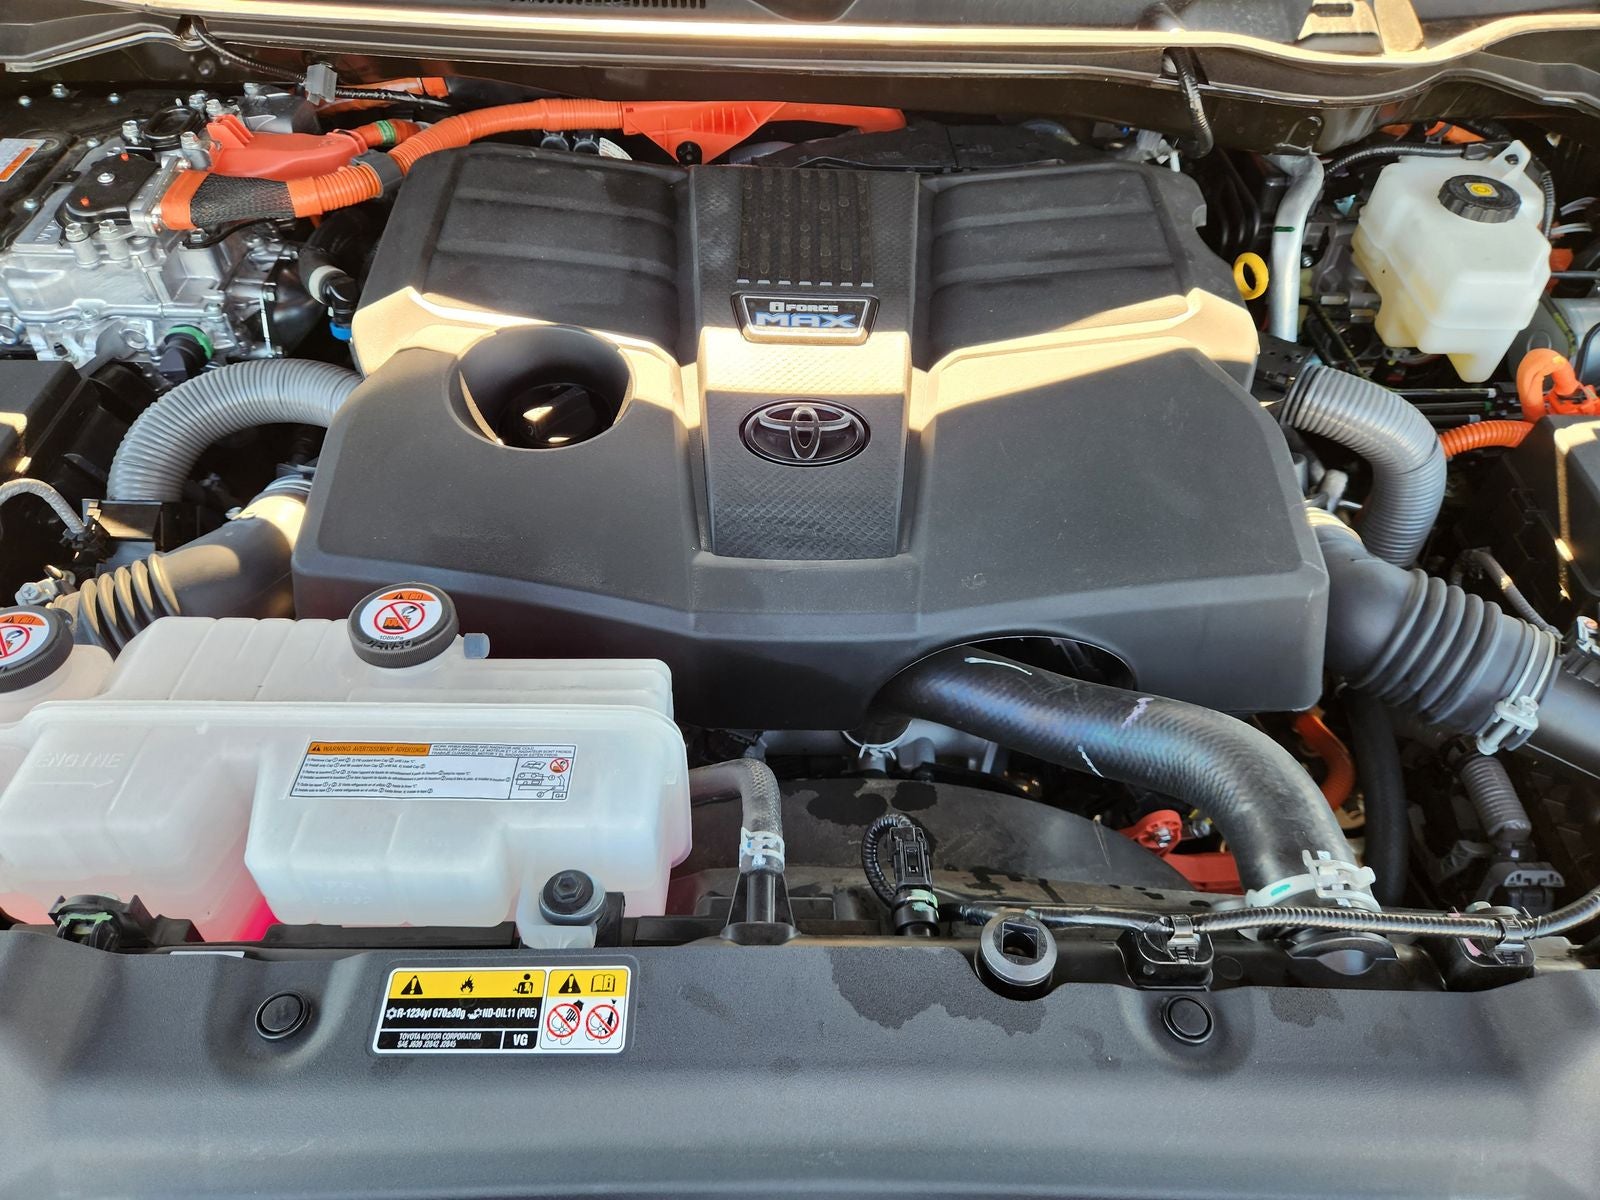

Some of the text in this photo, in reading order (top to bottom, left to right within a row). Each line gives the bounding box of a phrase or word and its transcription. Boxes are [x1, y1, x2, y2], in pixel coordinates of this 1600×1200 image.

[755, 311, 856, 328] MAX
[35, 751, 125, 768] ENGINE
[442, 1033, 481, 1041] CORPORATION
[513, 1034, 528, 1046] VG
